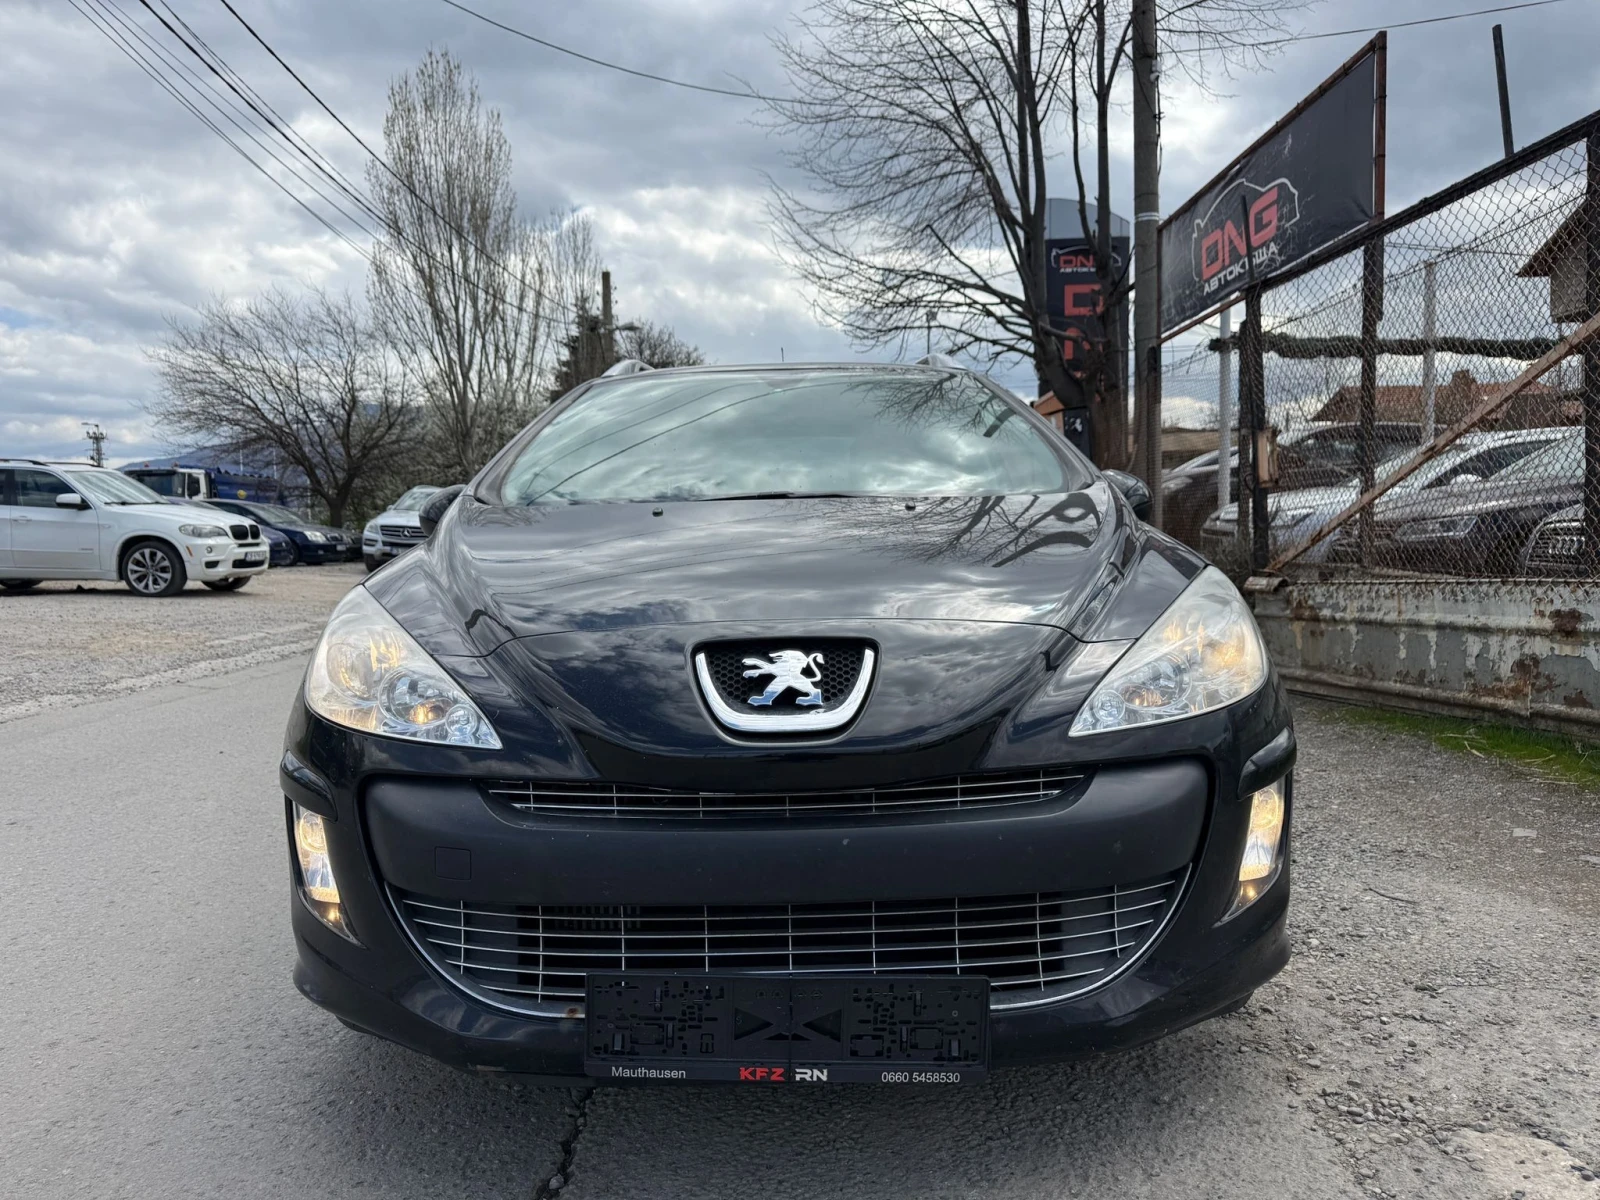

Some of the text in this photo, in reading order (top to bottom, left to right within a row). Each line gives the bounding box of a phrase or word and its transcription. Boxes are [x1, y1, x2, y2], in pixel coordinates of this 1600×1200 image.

[1202, 186, 1278, 282] DNG
[1059, 254, 1094, 268] DN
[611, 1066, 961, 1083] Mauthausen KFZ RN 0660 5458530
